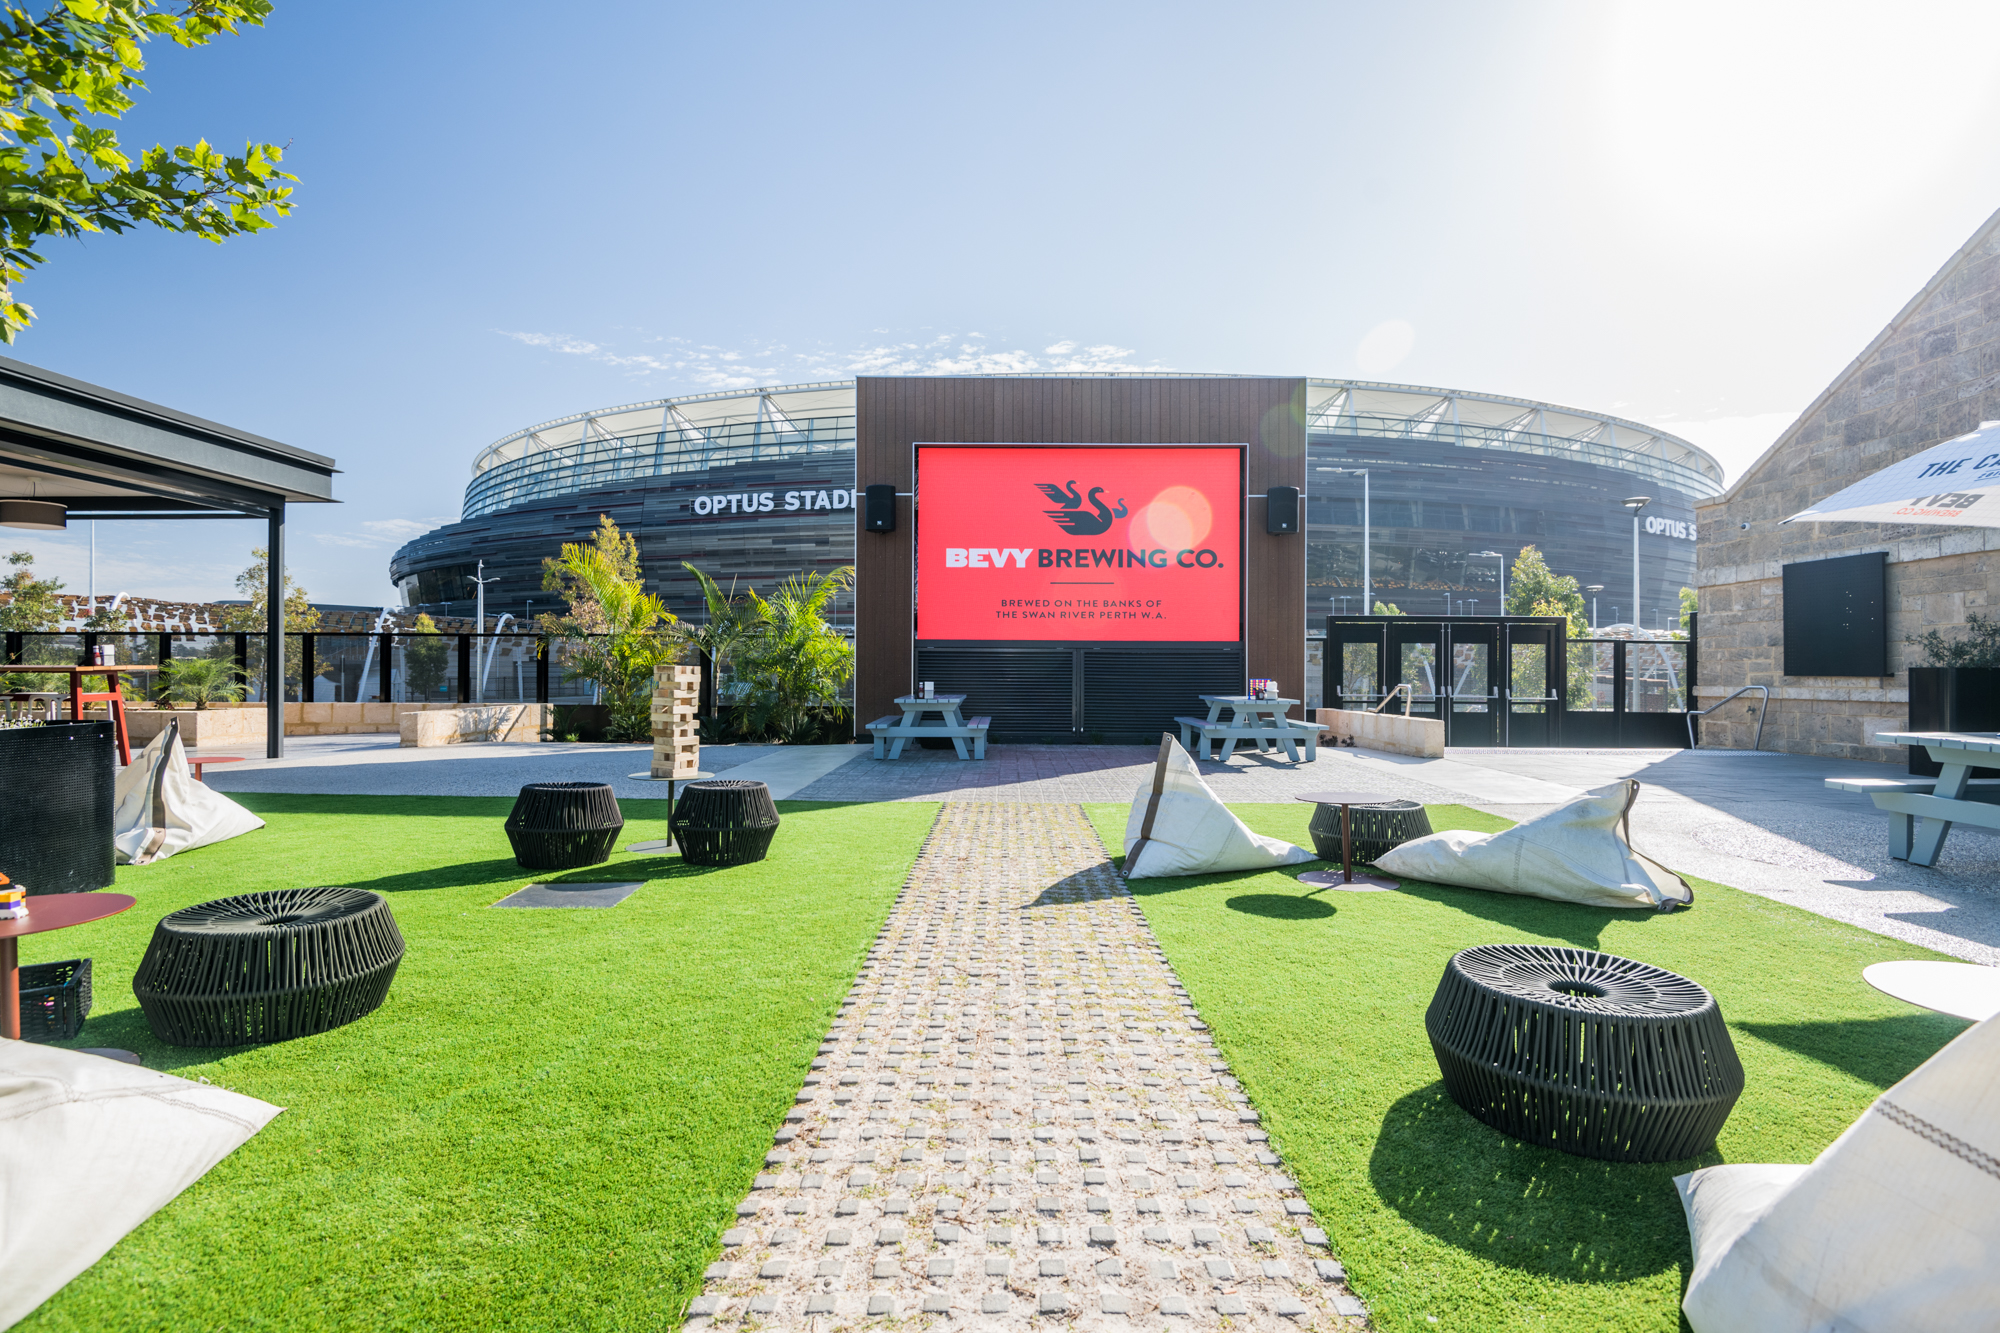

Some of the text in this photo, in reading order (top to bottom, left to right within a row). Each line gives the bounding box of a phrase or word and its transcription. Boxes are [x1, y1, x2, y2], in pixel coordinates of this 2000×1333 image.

[1917, 457, 1973, 479] THE
[694, 492, 775, 515] OPTUS
[1645, 516, 1687, 539] OPTUS
[946, 548, 1224, 568] BEVY BREWING CO.
[1001, 599, 1162, 608] BREWED ON THE BANKS OF
[996, 611, 1167, 620] THE SWAN RIVER PERTH W.A.
